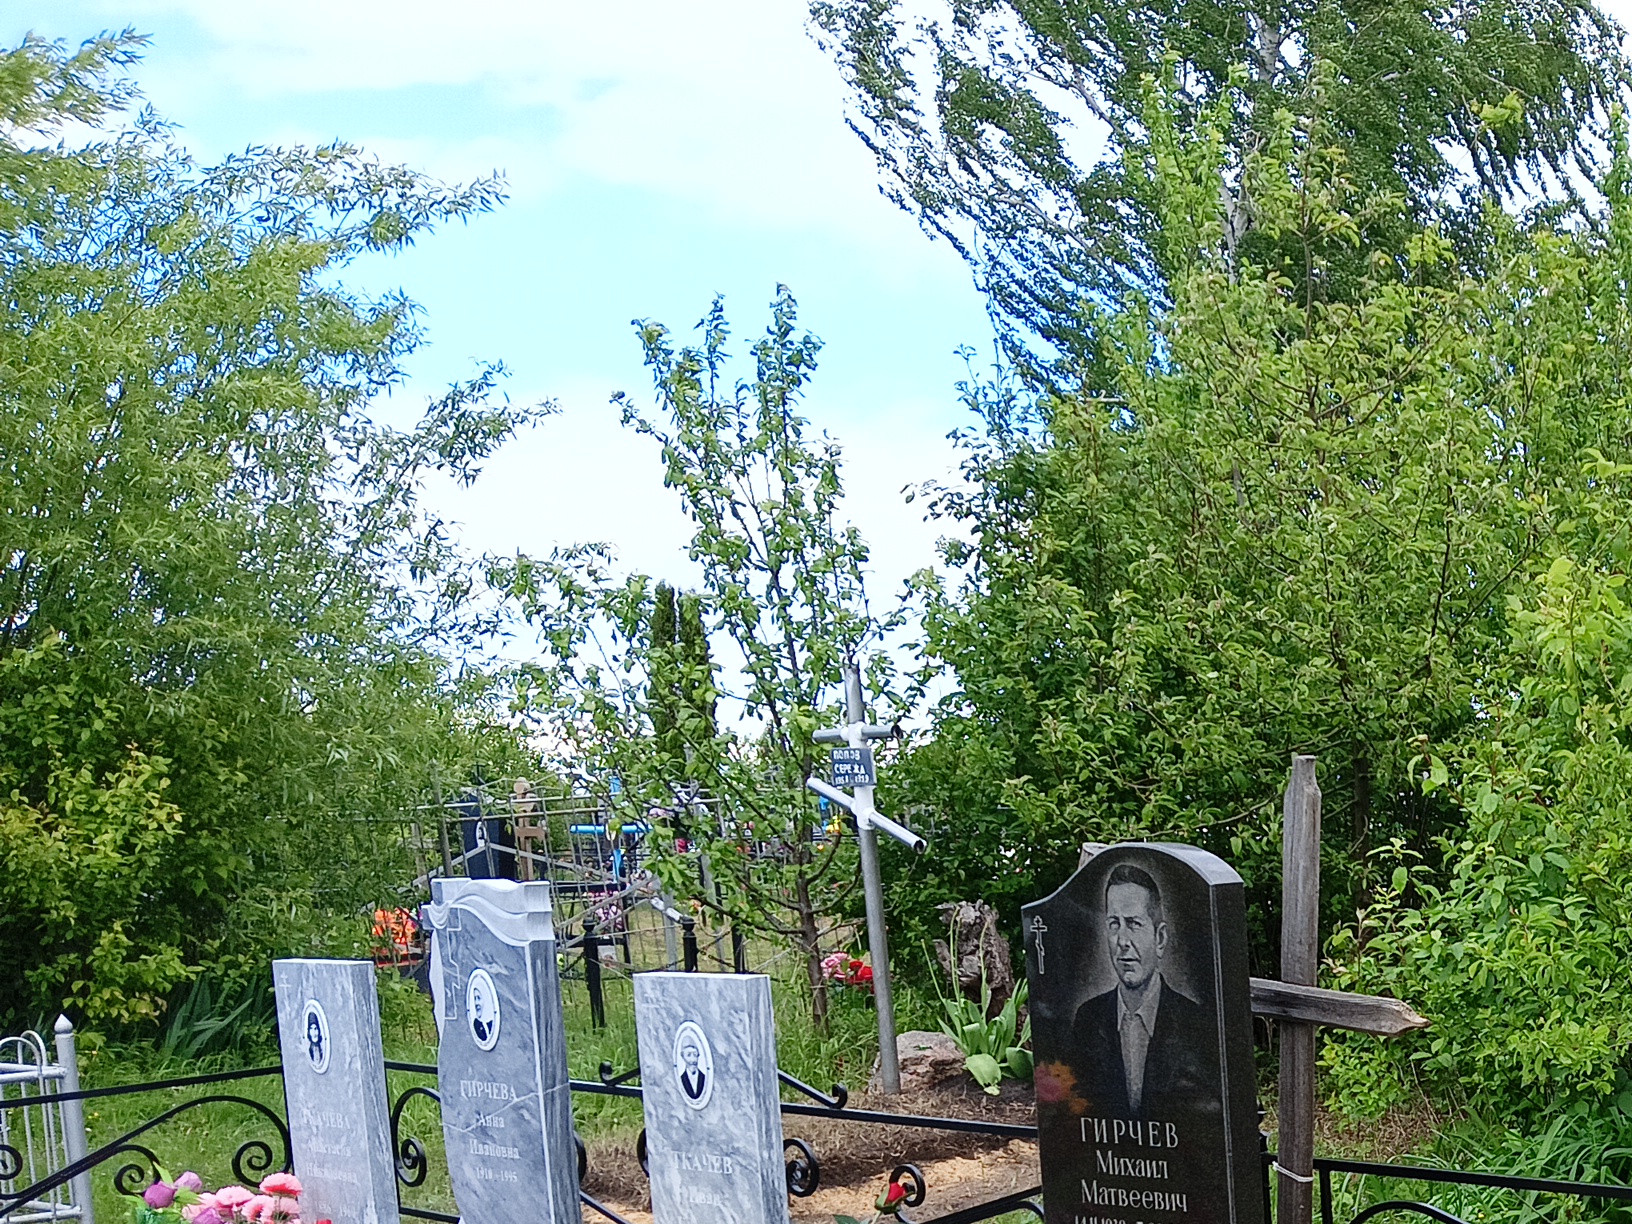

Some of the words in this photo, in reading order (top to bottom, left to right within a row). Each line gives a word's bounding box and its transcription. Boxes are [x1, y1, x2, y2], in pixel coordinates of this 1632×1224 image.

[460, 1080, 517, 1100] ГИРЧЕВА
[477, 1111, 504, 1127] Анна
[1080, 1117, 1179, 1148] ГИРЧЕВ
[470, 1139, 520, 1159] Ивановна
[673, 1152, 732, 1174] ТКАЧЕВ
[1096, 1150, 1168, 1179] Михаил
[1081, 1179, 1188, 1212] Матвеевич
